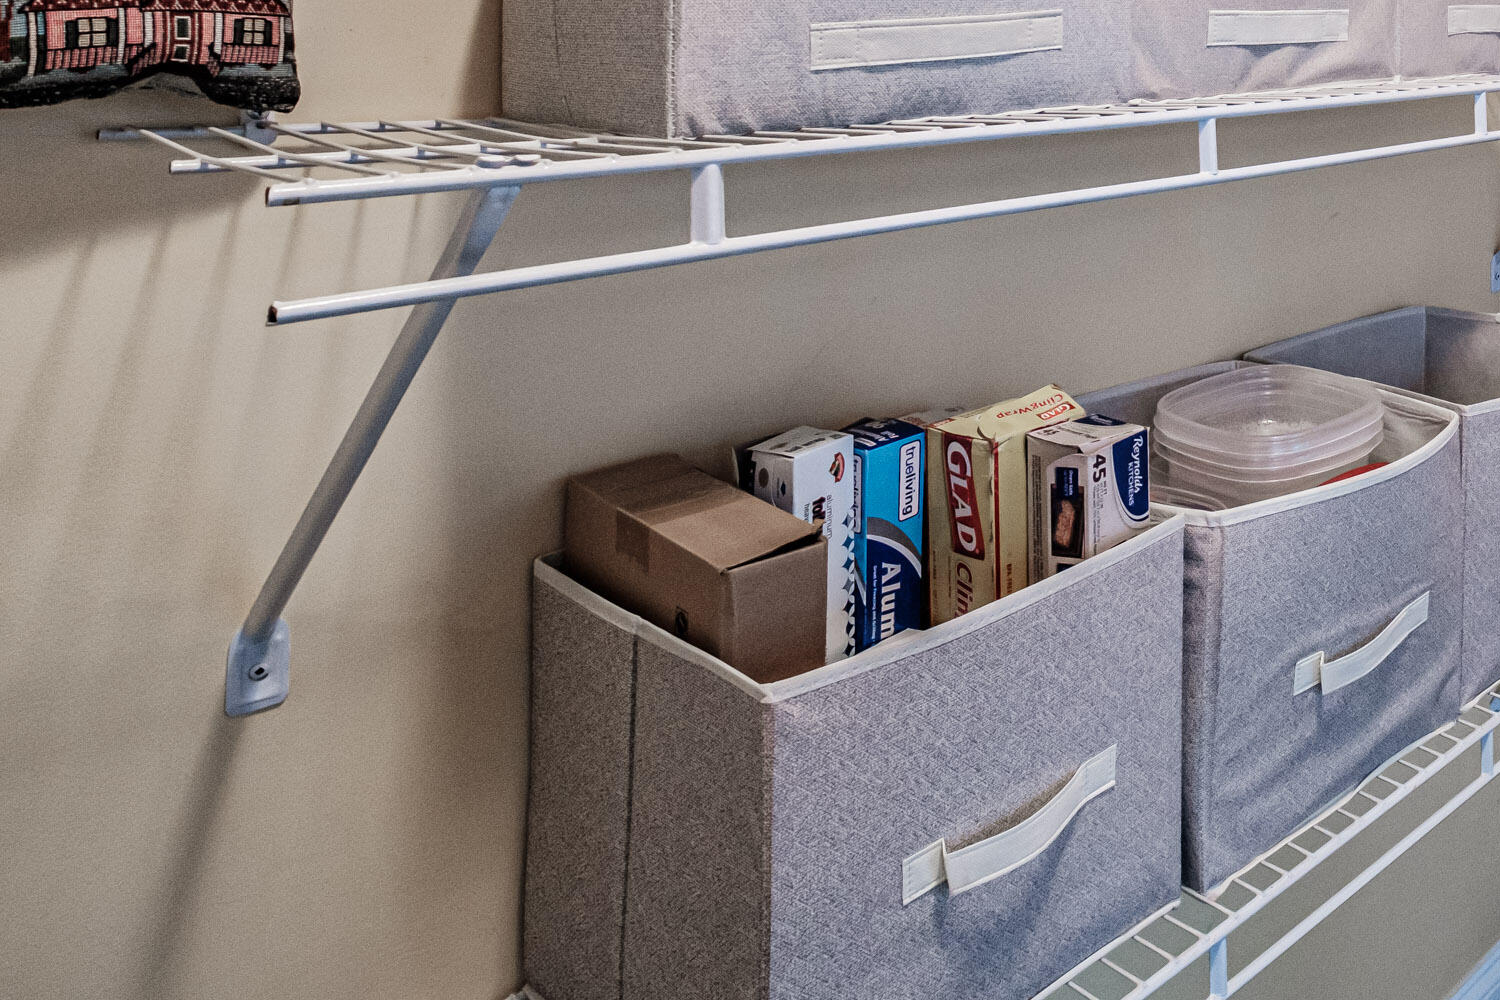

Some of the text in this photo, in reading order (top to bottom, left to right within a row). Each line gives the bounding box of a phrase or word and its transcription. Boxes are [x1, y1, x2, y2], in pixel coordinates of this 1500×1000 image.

[1040, 403, 1071, 420] GLAD
[902, 445, 917, 517] trueliving
[1092, 454, 1107, 483] 45
[1132, 435, 1144, 494] Reynolds
[947, 441, 978, 553] GLAD
[880, 562, 902, 640] Alum
[955, 561, 973, 617] Clin
